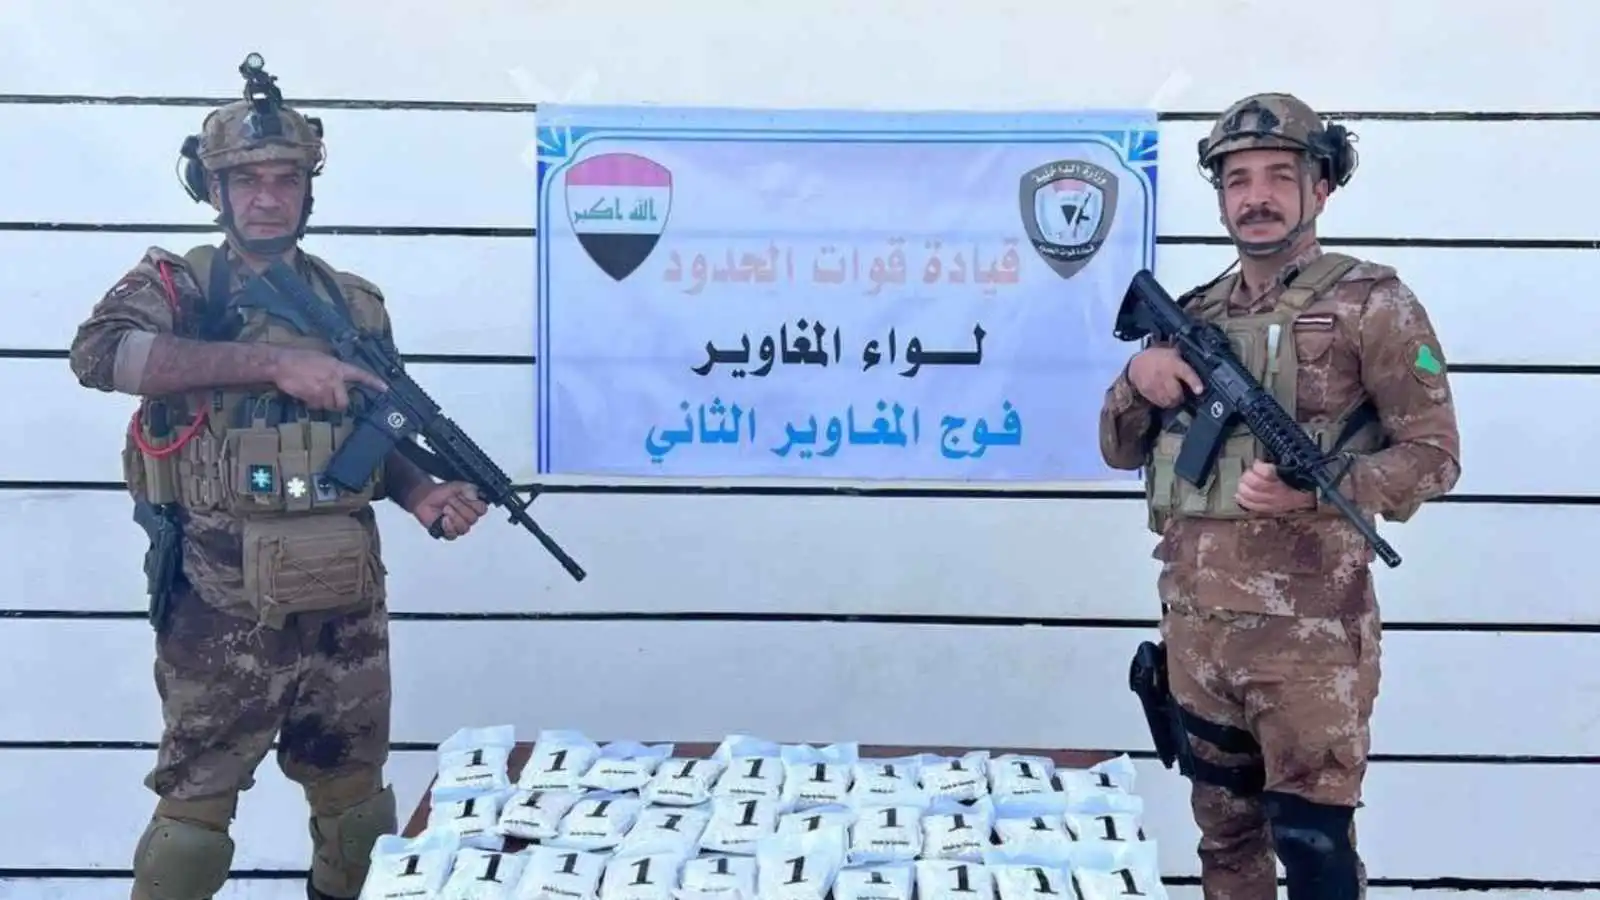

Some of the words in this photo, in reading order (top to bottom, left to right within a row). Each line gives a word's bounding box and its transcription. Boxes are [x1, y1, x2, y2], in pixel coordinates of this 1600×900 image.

[663, 240, 795, 296] الحدود
[812, 237, 906, 296] قوات
[922, 237, 1021, 297] قيادة
[691, 318, 841, 378] المغاوير
[645, 397, 756, 463] الثاني
[770, 400, 919, 460] المغاوير
[939, 400, 1023, 460] فوج
[466, 749, 488, 767] 1
[544, 750, 568, 772] 1
[672, 759, 698, 779] 1
[743, 758, 764, 779] 1
[1012, 758, 1040, 780] 1
[809, 762, 831, 782] 1
[1090, 772, 1118, 788] 1
[455, 797, 479, 819] 1
[586, 799, 611, 818] 1
[735, 800, 758, 827] 1
[879, 808, 903, 828] 1
[657, 814, 683, 832] 1
[946, 811, 973, 833] 1
[1095, 815, 1125, 841] 1
[398, 854, 422, 877] 1
[477, 853, 502, 884] 1
[555, 853, 579, 876] 1
[628, 858, 654, 886] 1
[709, 857, 737, 875] 1
[784, 856, 808, 884] 1
[950, 863, 976, 893] 1
[1028, 866, 1058, 895] 1
[1111, 868, 1146, 896] 1
